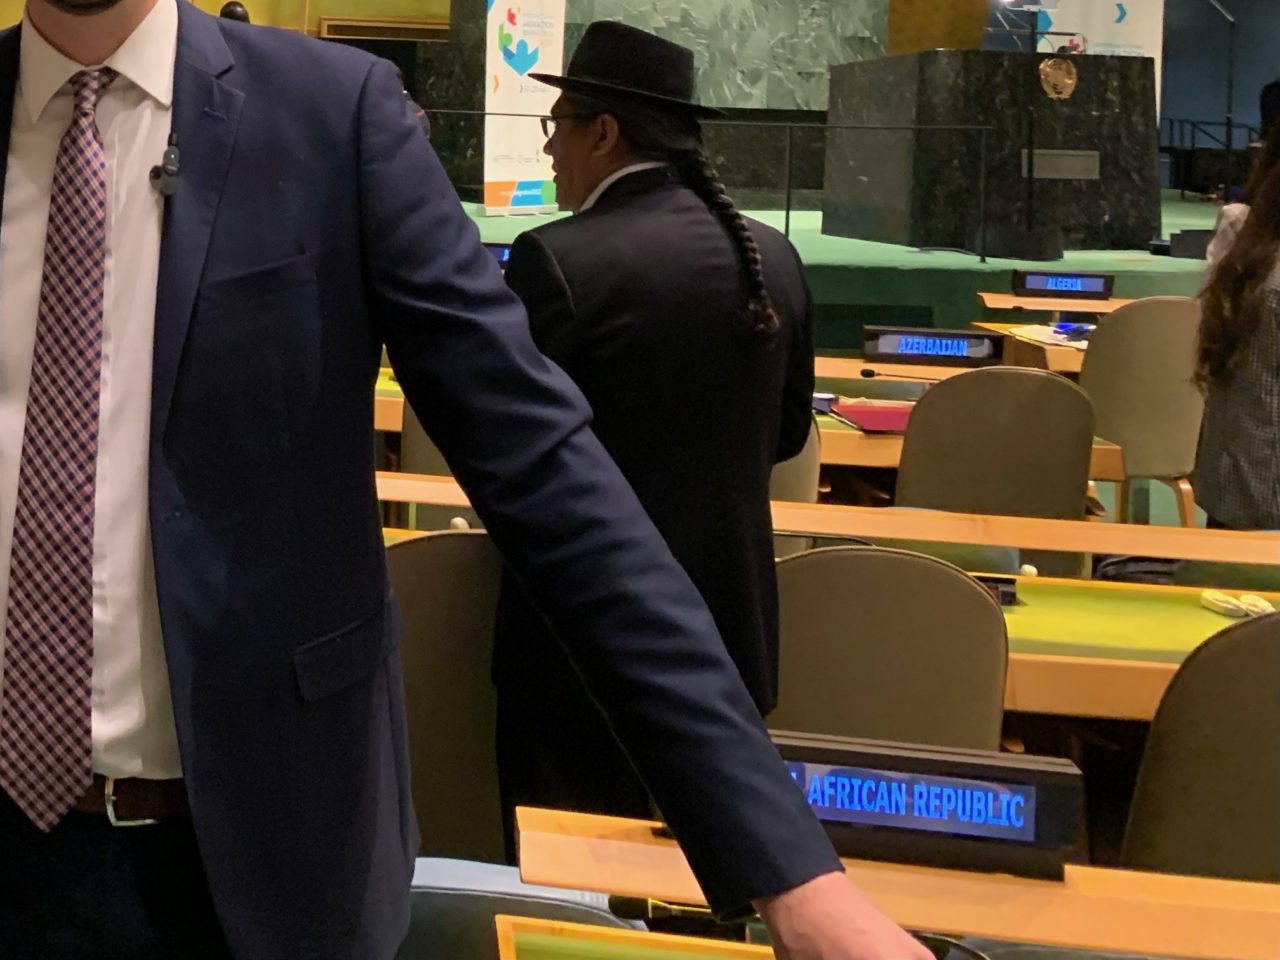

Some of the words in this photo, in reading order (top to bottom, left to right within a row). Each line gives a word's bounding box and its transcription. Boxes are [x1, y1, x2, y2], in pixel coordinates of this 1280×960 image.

[1046, 275, 1082, 291] ALGERIA
[897, 336, 968, 357] AZERBAIJAN
[808, 774, 906, 816] AFRICAN
[913, 783, 1025, 828] REPUBLIC
